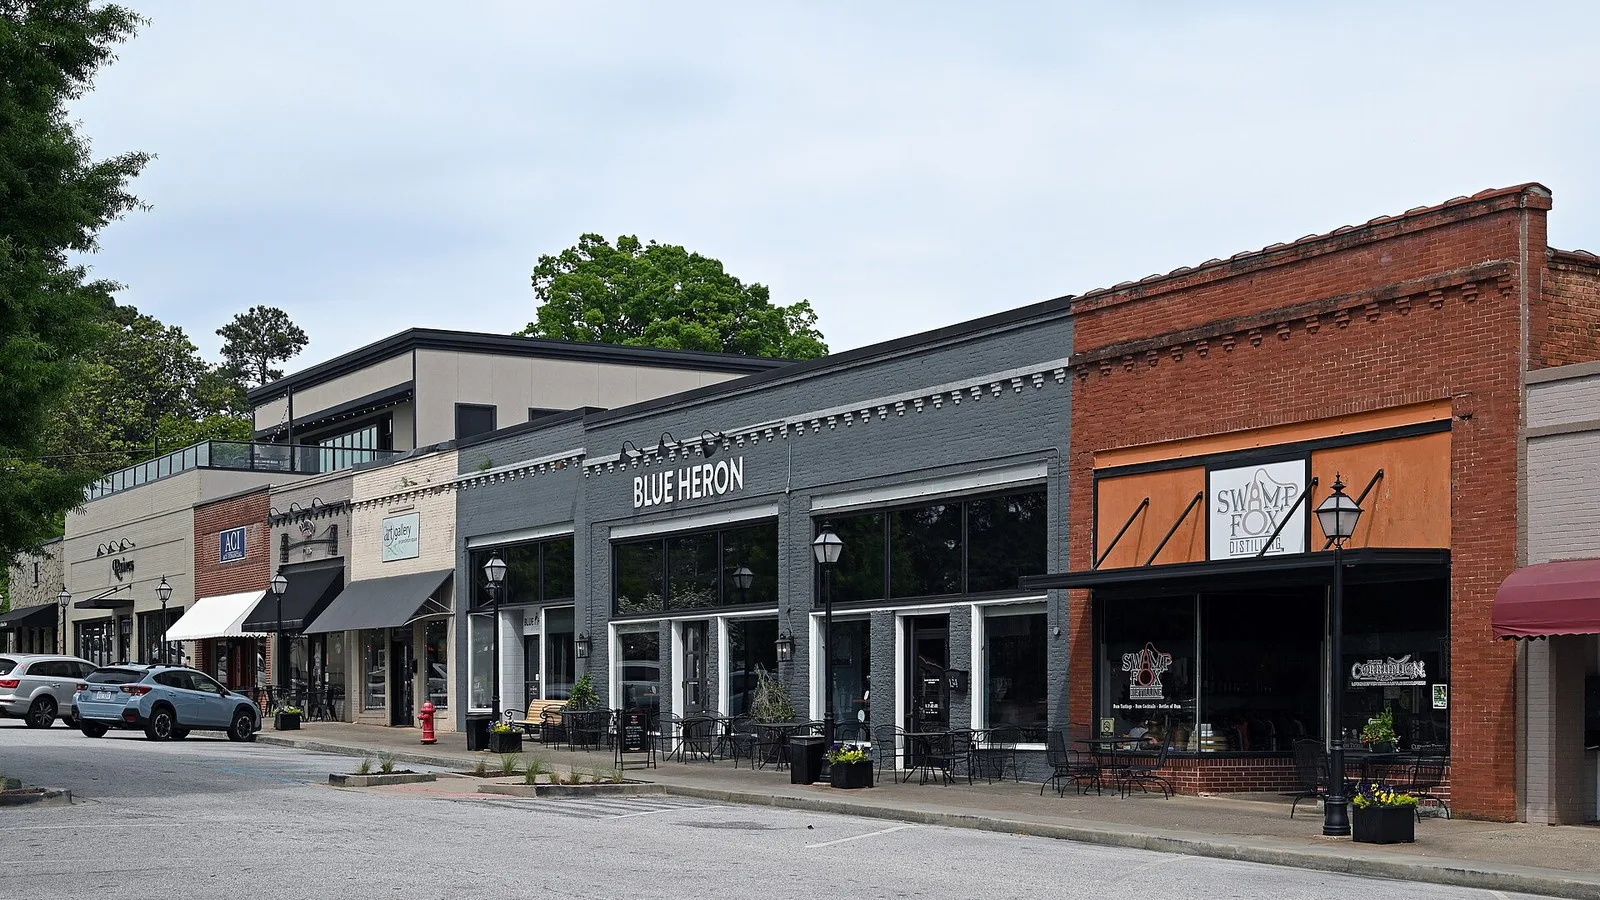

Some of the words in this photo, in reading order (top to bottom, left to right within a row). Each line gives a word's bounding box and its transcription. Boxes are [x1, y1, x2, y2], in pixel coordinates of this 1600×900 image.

[633, 470, 674, 508] BLUE
[678, 456, 743, 501] HERON
[1217, 480, 1298, 513] SWAMP
[394, 524, 412, 541] gallery
[1230, 509, 1281, 537] FOX
[225, 531, 240, 552] ACI
[1122, 649, 1172, 671] SWAMP
[1130, 668, 1163, 687] FOX
